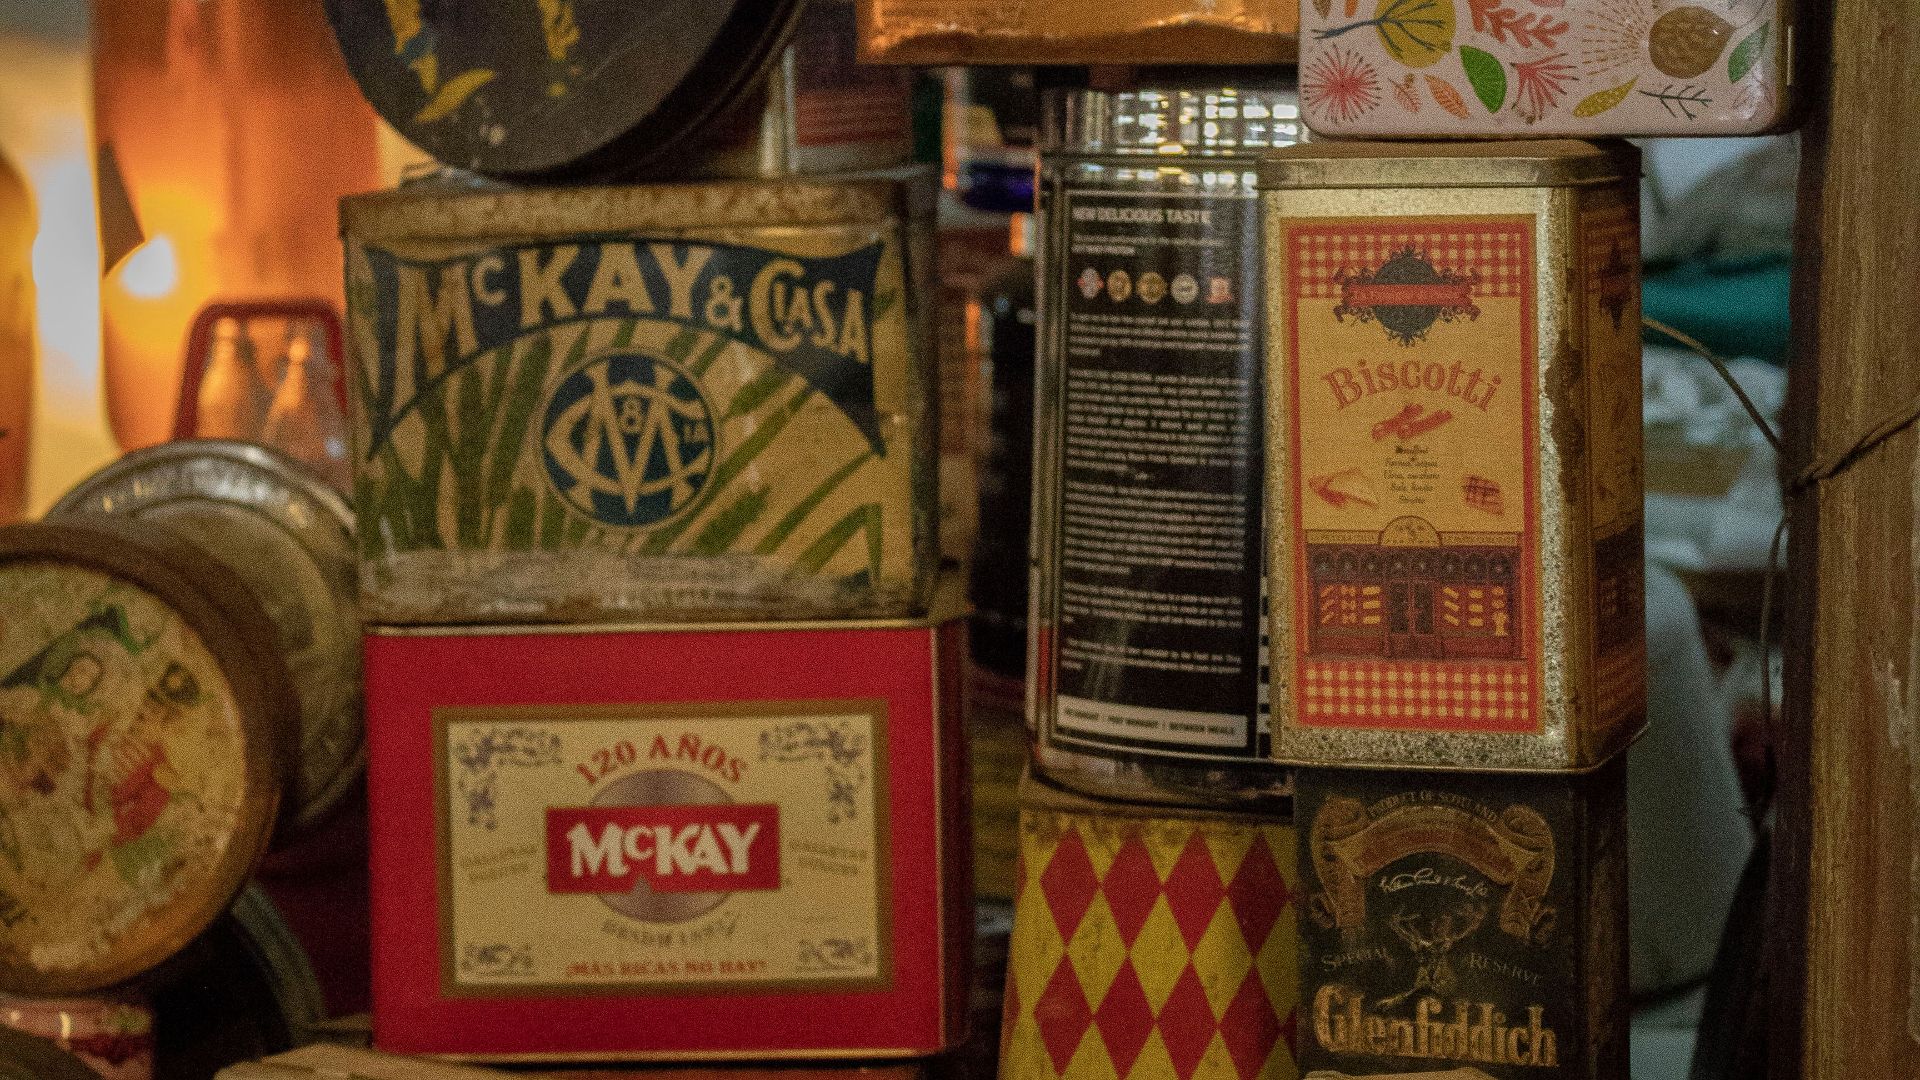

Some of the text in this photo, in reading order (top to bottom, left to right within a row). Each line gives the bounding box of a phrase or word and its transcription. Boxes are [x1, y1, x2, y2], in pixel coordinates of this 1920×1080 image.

[1166, 208, 1212, 225] TASTE
[704, 276, 744, 332] &
[1321, 356, 1502, 411] Biscotti
[575, 731, 748, 785] 120 AÑOS
[1313, 984, 1559, 1068] Glenfiddich
